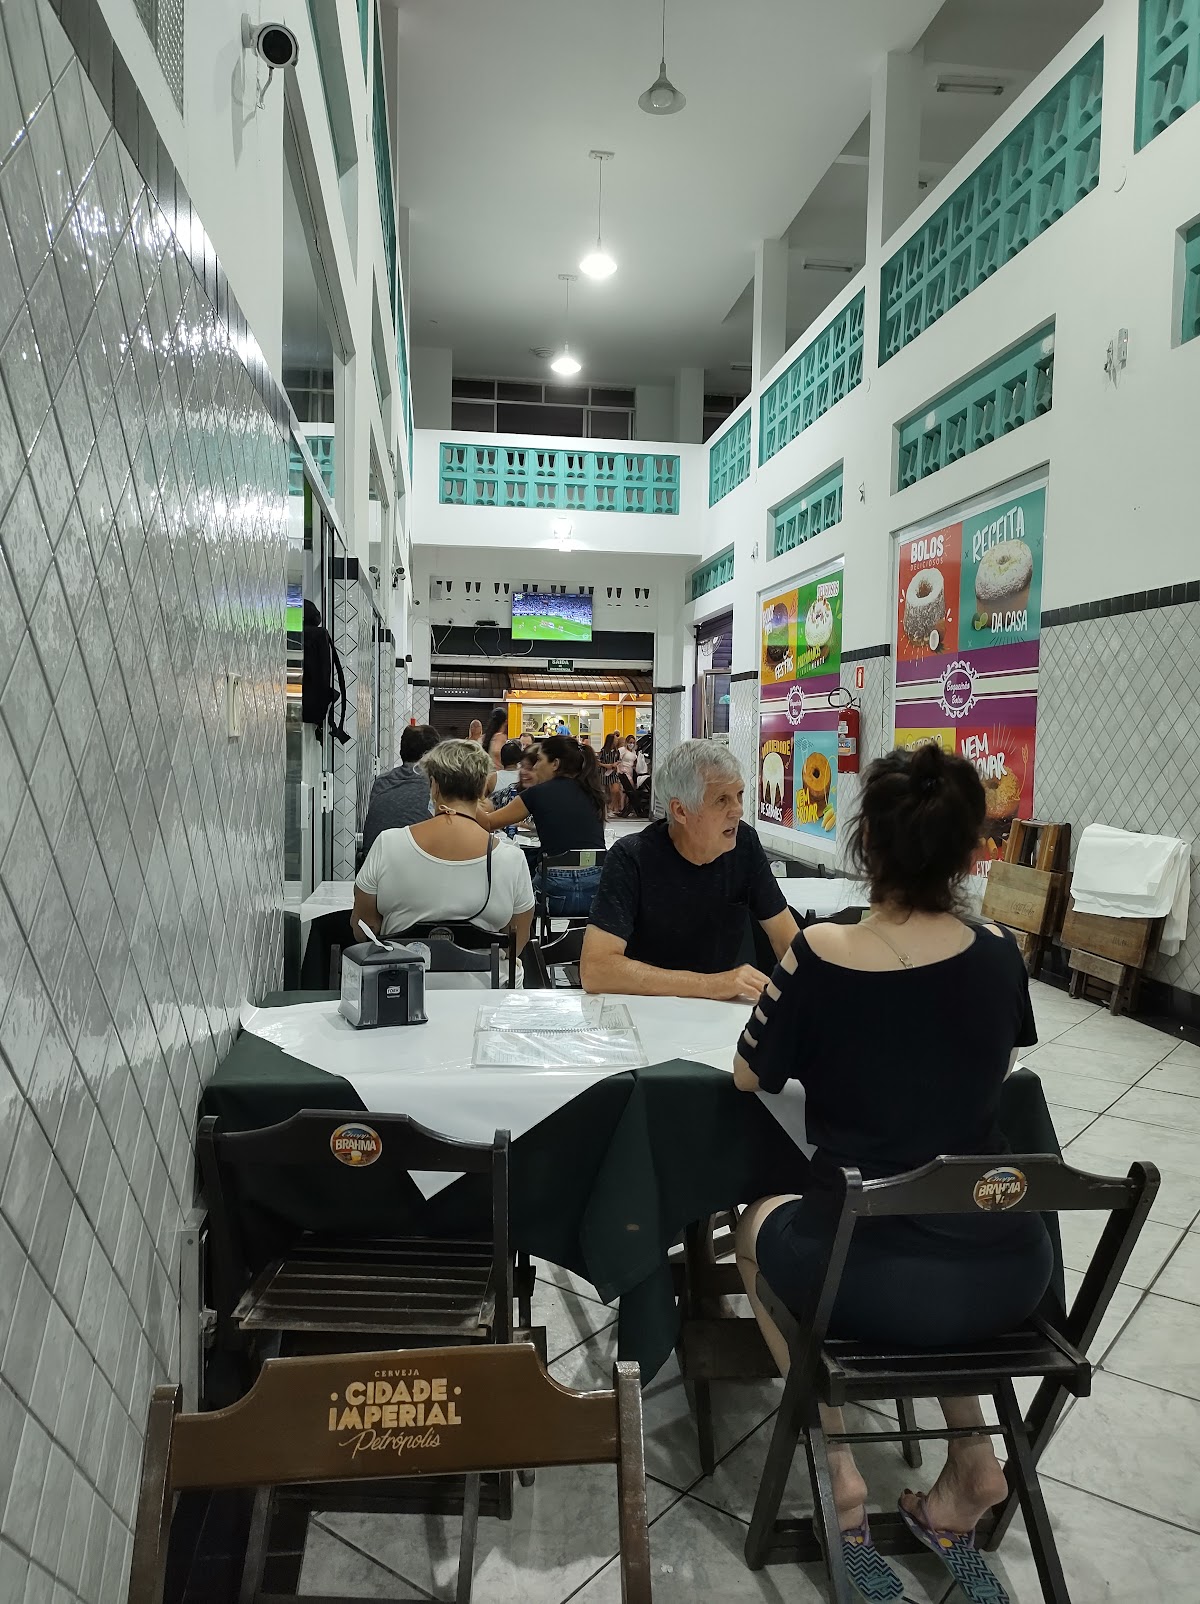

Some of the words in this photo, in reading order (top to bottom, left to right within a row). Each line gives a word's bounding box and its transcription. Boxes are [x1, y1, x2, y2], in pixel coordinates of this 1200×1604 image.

[972, 506, 1025, 563] RECEITA
[910, 534, 944, 564] BOLOS
[910, 557, 943, 572] DELICIOSOS
[991, 611, 1003, 634] DA
[1004, 609, 1028, 633] CASA
[961, 732, 989, 760] VEM
[795, 788, 810, 808] VEM
[797, 802, 818, 824] PROVAR
[335, 1138, 377, 1151] BRAHMA
[978, 1181, 1021, 1197] BRAHMA
[374, 1369, 420, 1378] CERVEJA
[345, 1378, 448, 1406] CIDADE
[328, 1401, 462, 1432] IMPERIAL
[338, 1427, 442, 1459] Petrópolis
